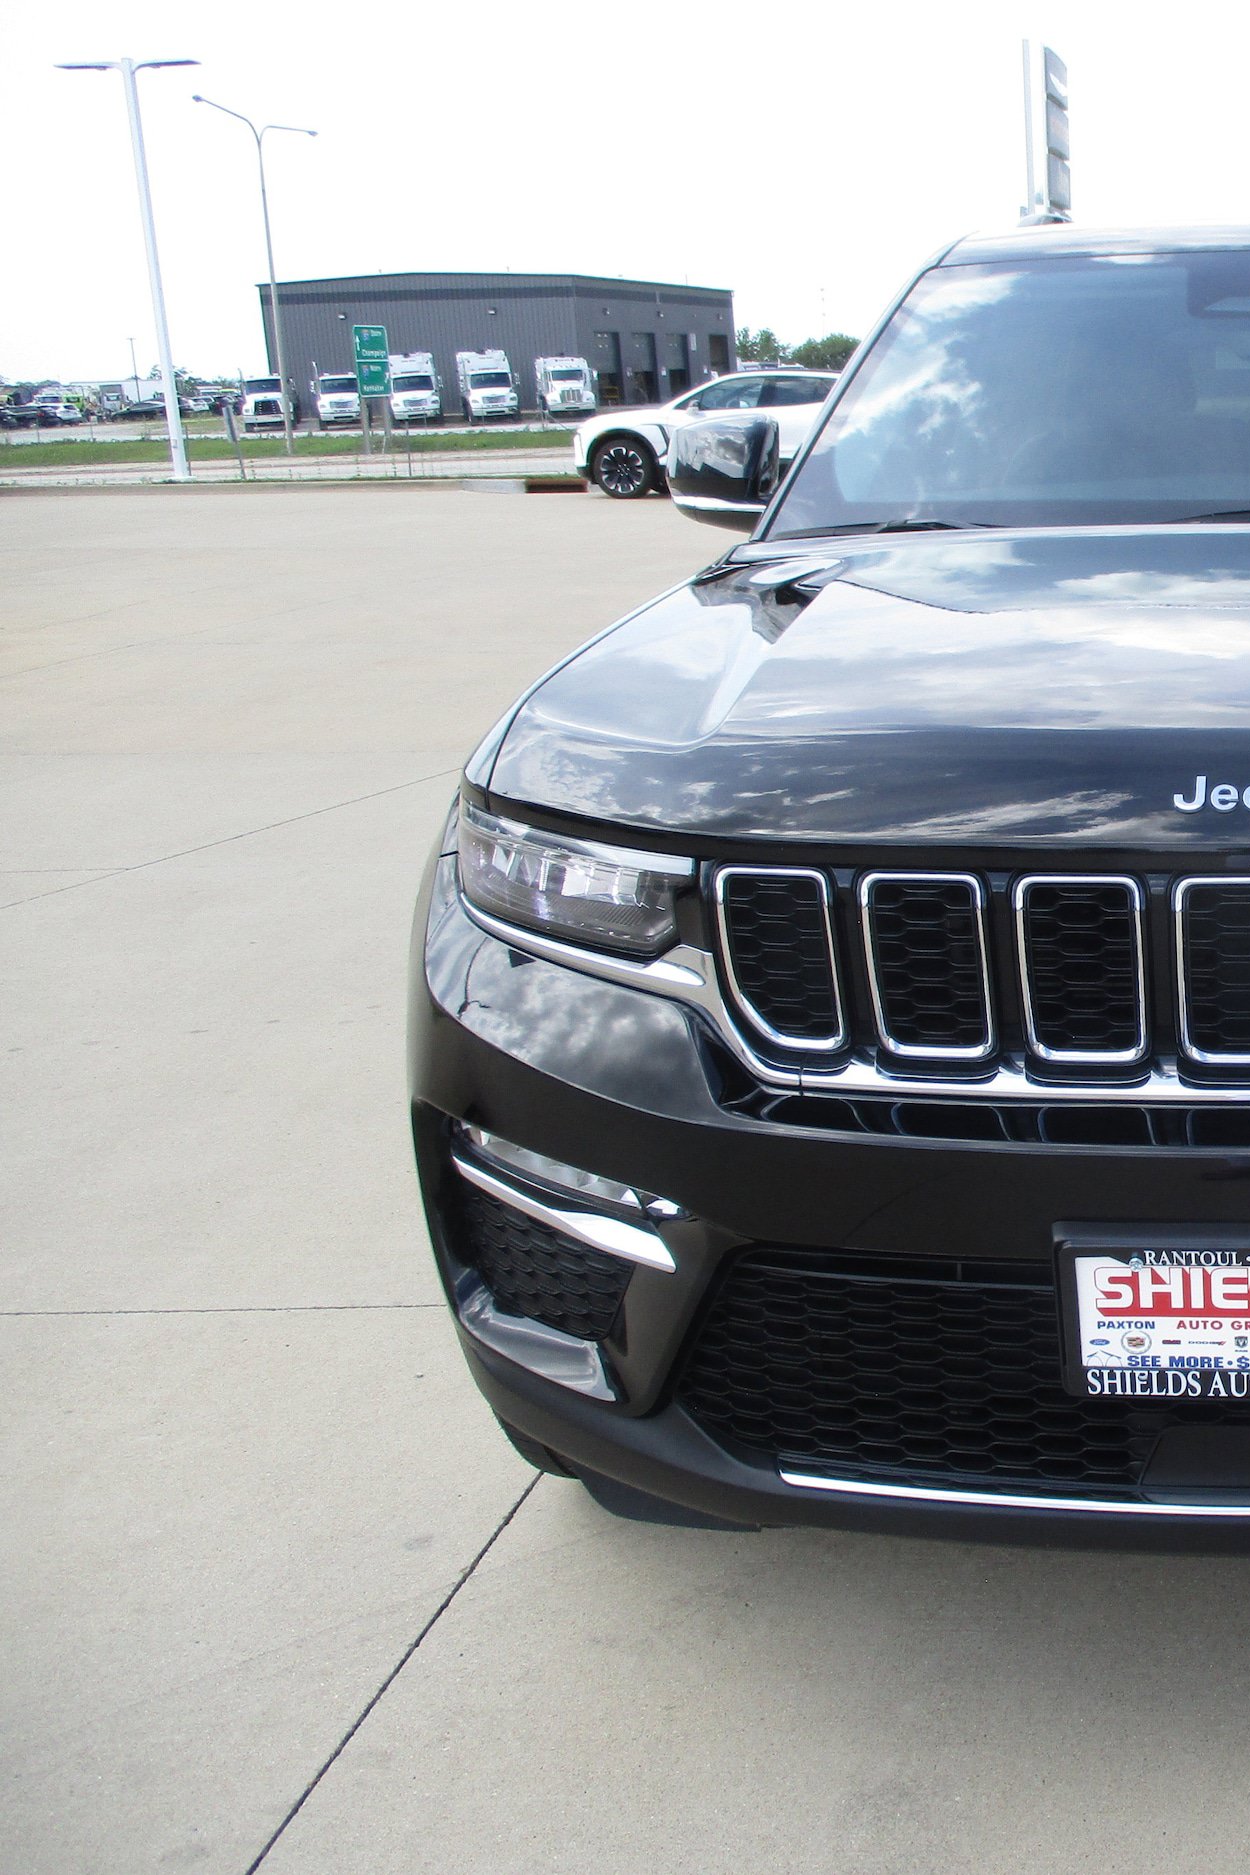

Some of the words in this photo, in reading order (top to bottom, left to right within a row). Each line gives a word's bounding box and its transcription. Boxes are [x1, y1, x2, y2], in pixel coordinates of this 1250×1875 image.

[1143, 1250, 1242, 1266] RANTOUL
[1097, 1320, 1156, 1330] PAXTON
[1176, 1320, 1223, 1330] AUTO
[1127, 1355, 1161, 1367] SEE
[1169, 1355, 1224, 1368] MORE
[1086, 1368, 1202, 1397] SHIELDS
